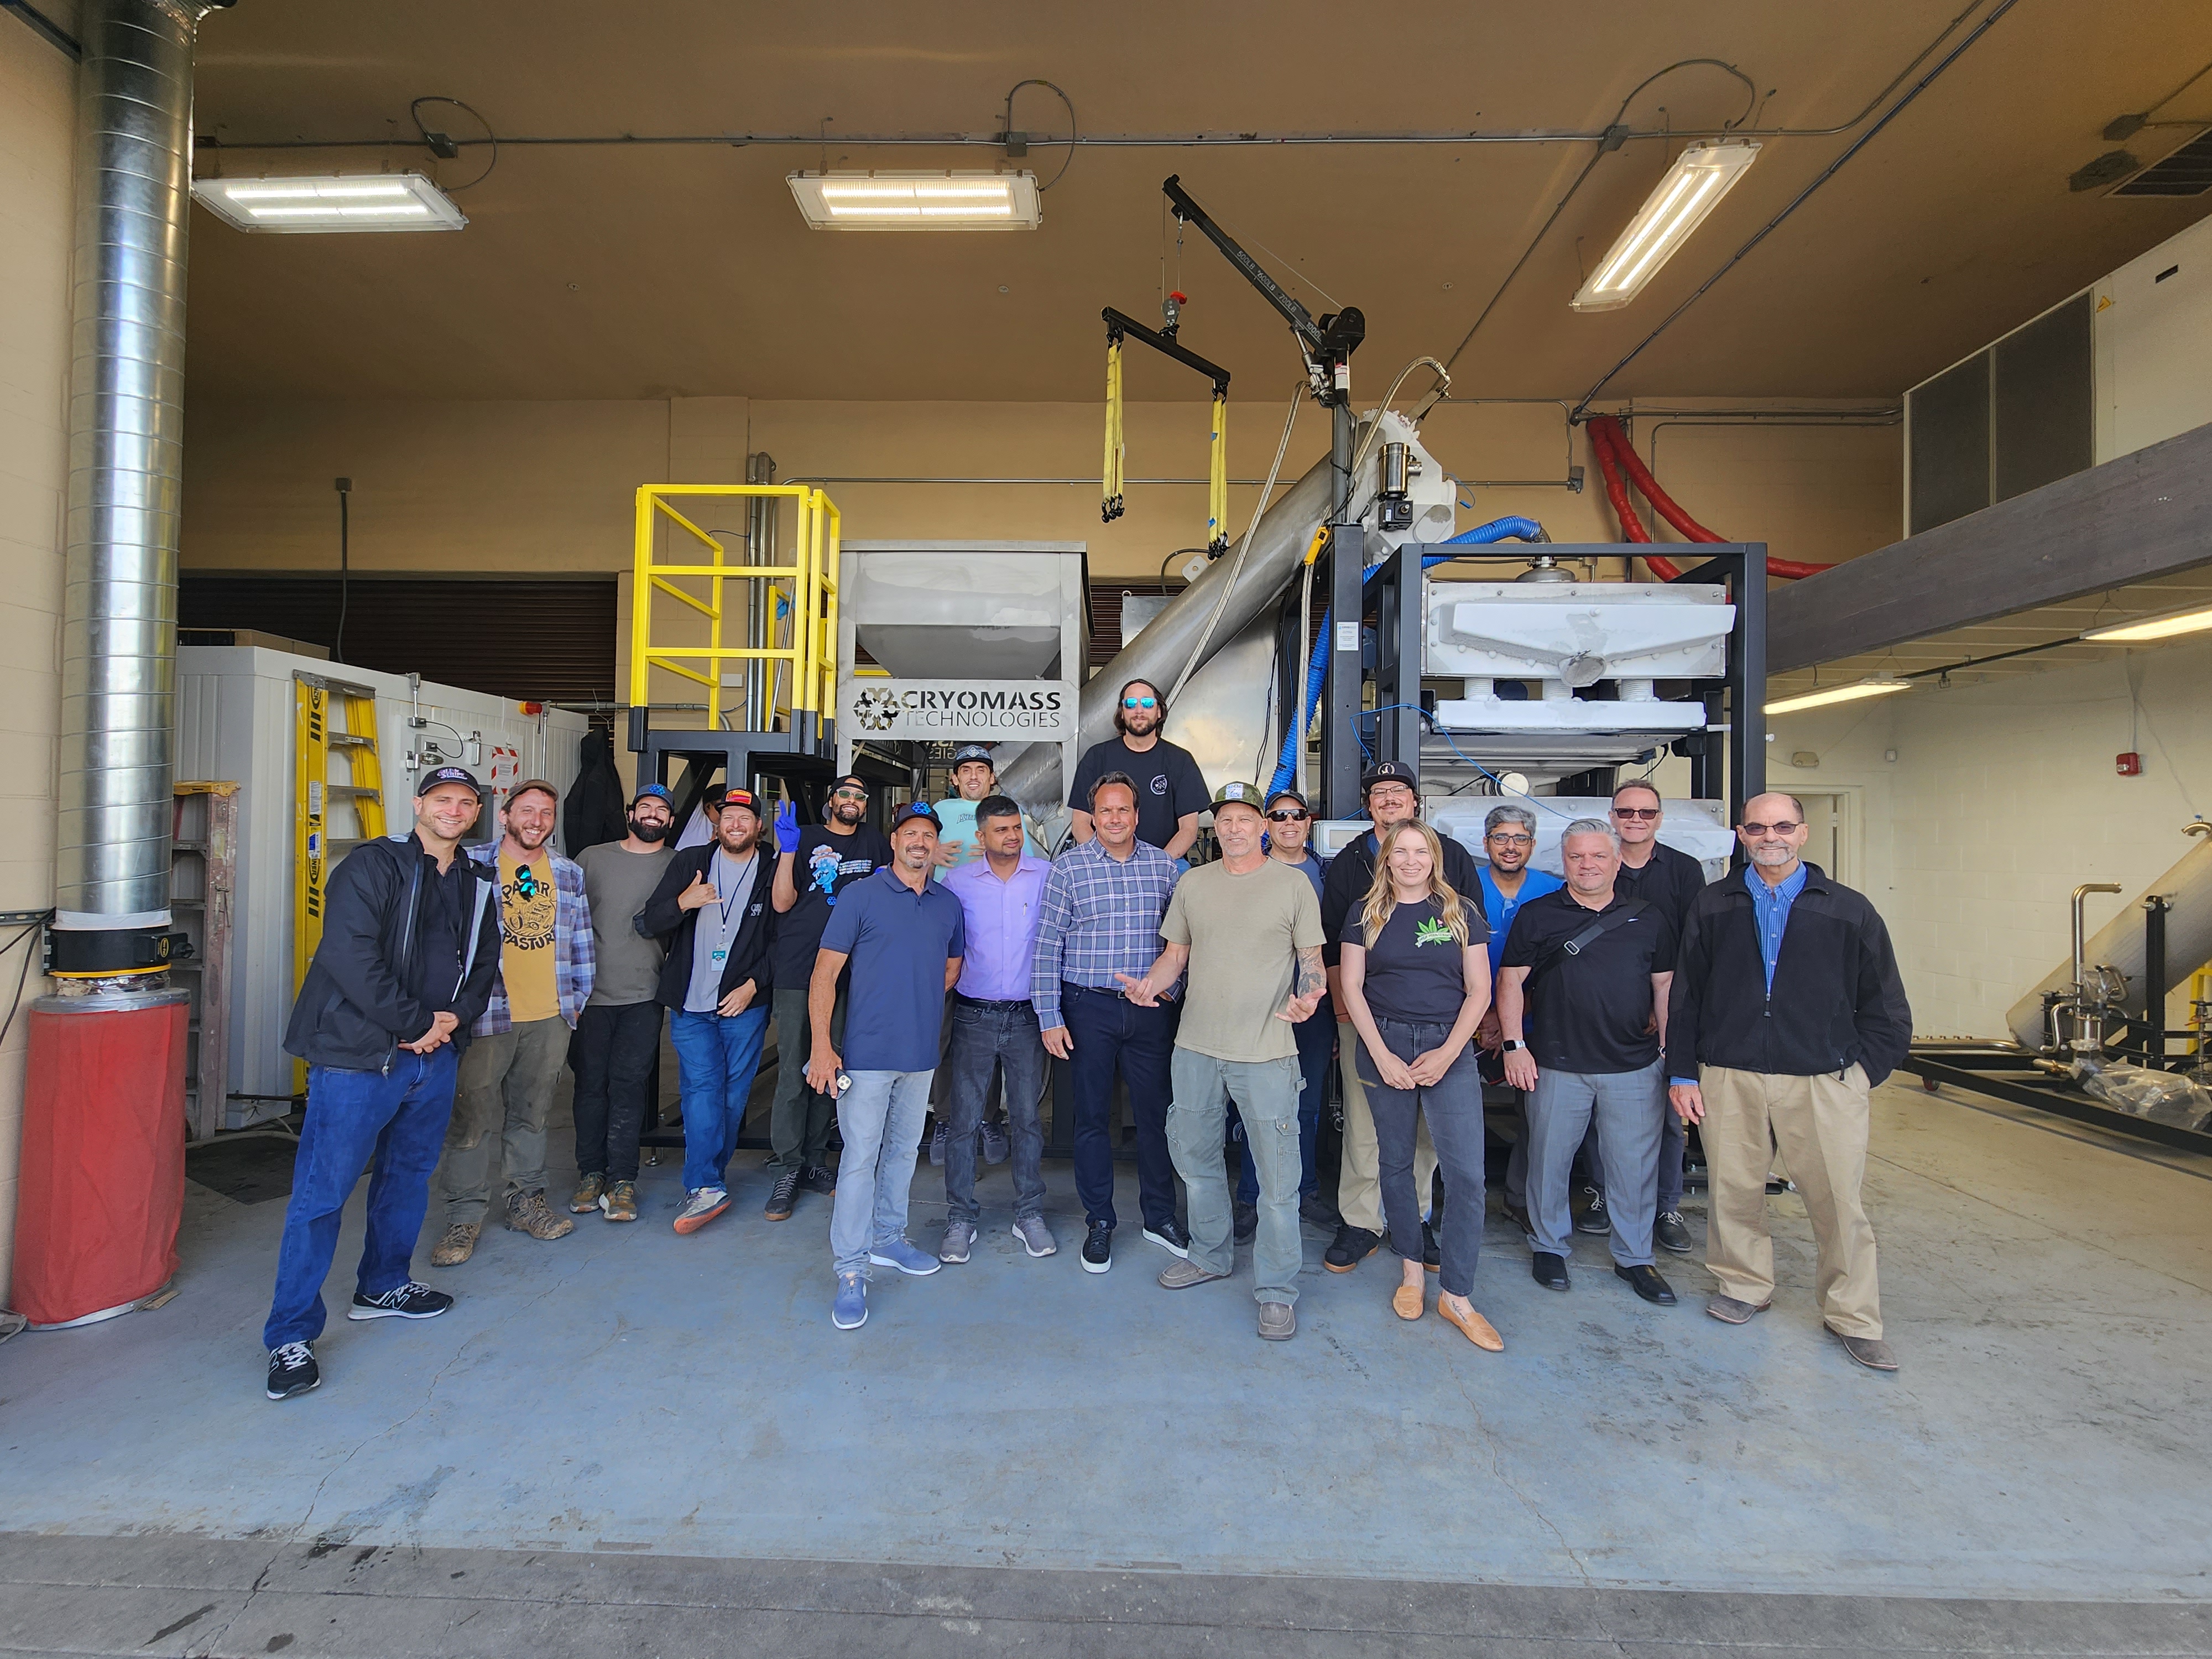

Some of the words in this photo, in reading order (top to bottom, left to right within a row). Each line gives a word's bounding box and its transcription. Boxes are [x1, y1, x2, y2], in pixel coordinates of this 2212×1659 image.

[1237, 251, 1255, 270] 500LB
[1257, 272, 1276, 291] 600LB
[1279, 293, 1297, 313] 700LB
[1306, 322, 1322, 342] 1000L
[901, 690, 1061, 711] CRYOMASS
[903, 711, 1060, 727] TECHNOLOGIES
[503, 927, 555, 951] PASTUR
